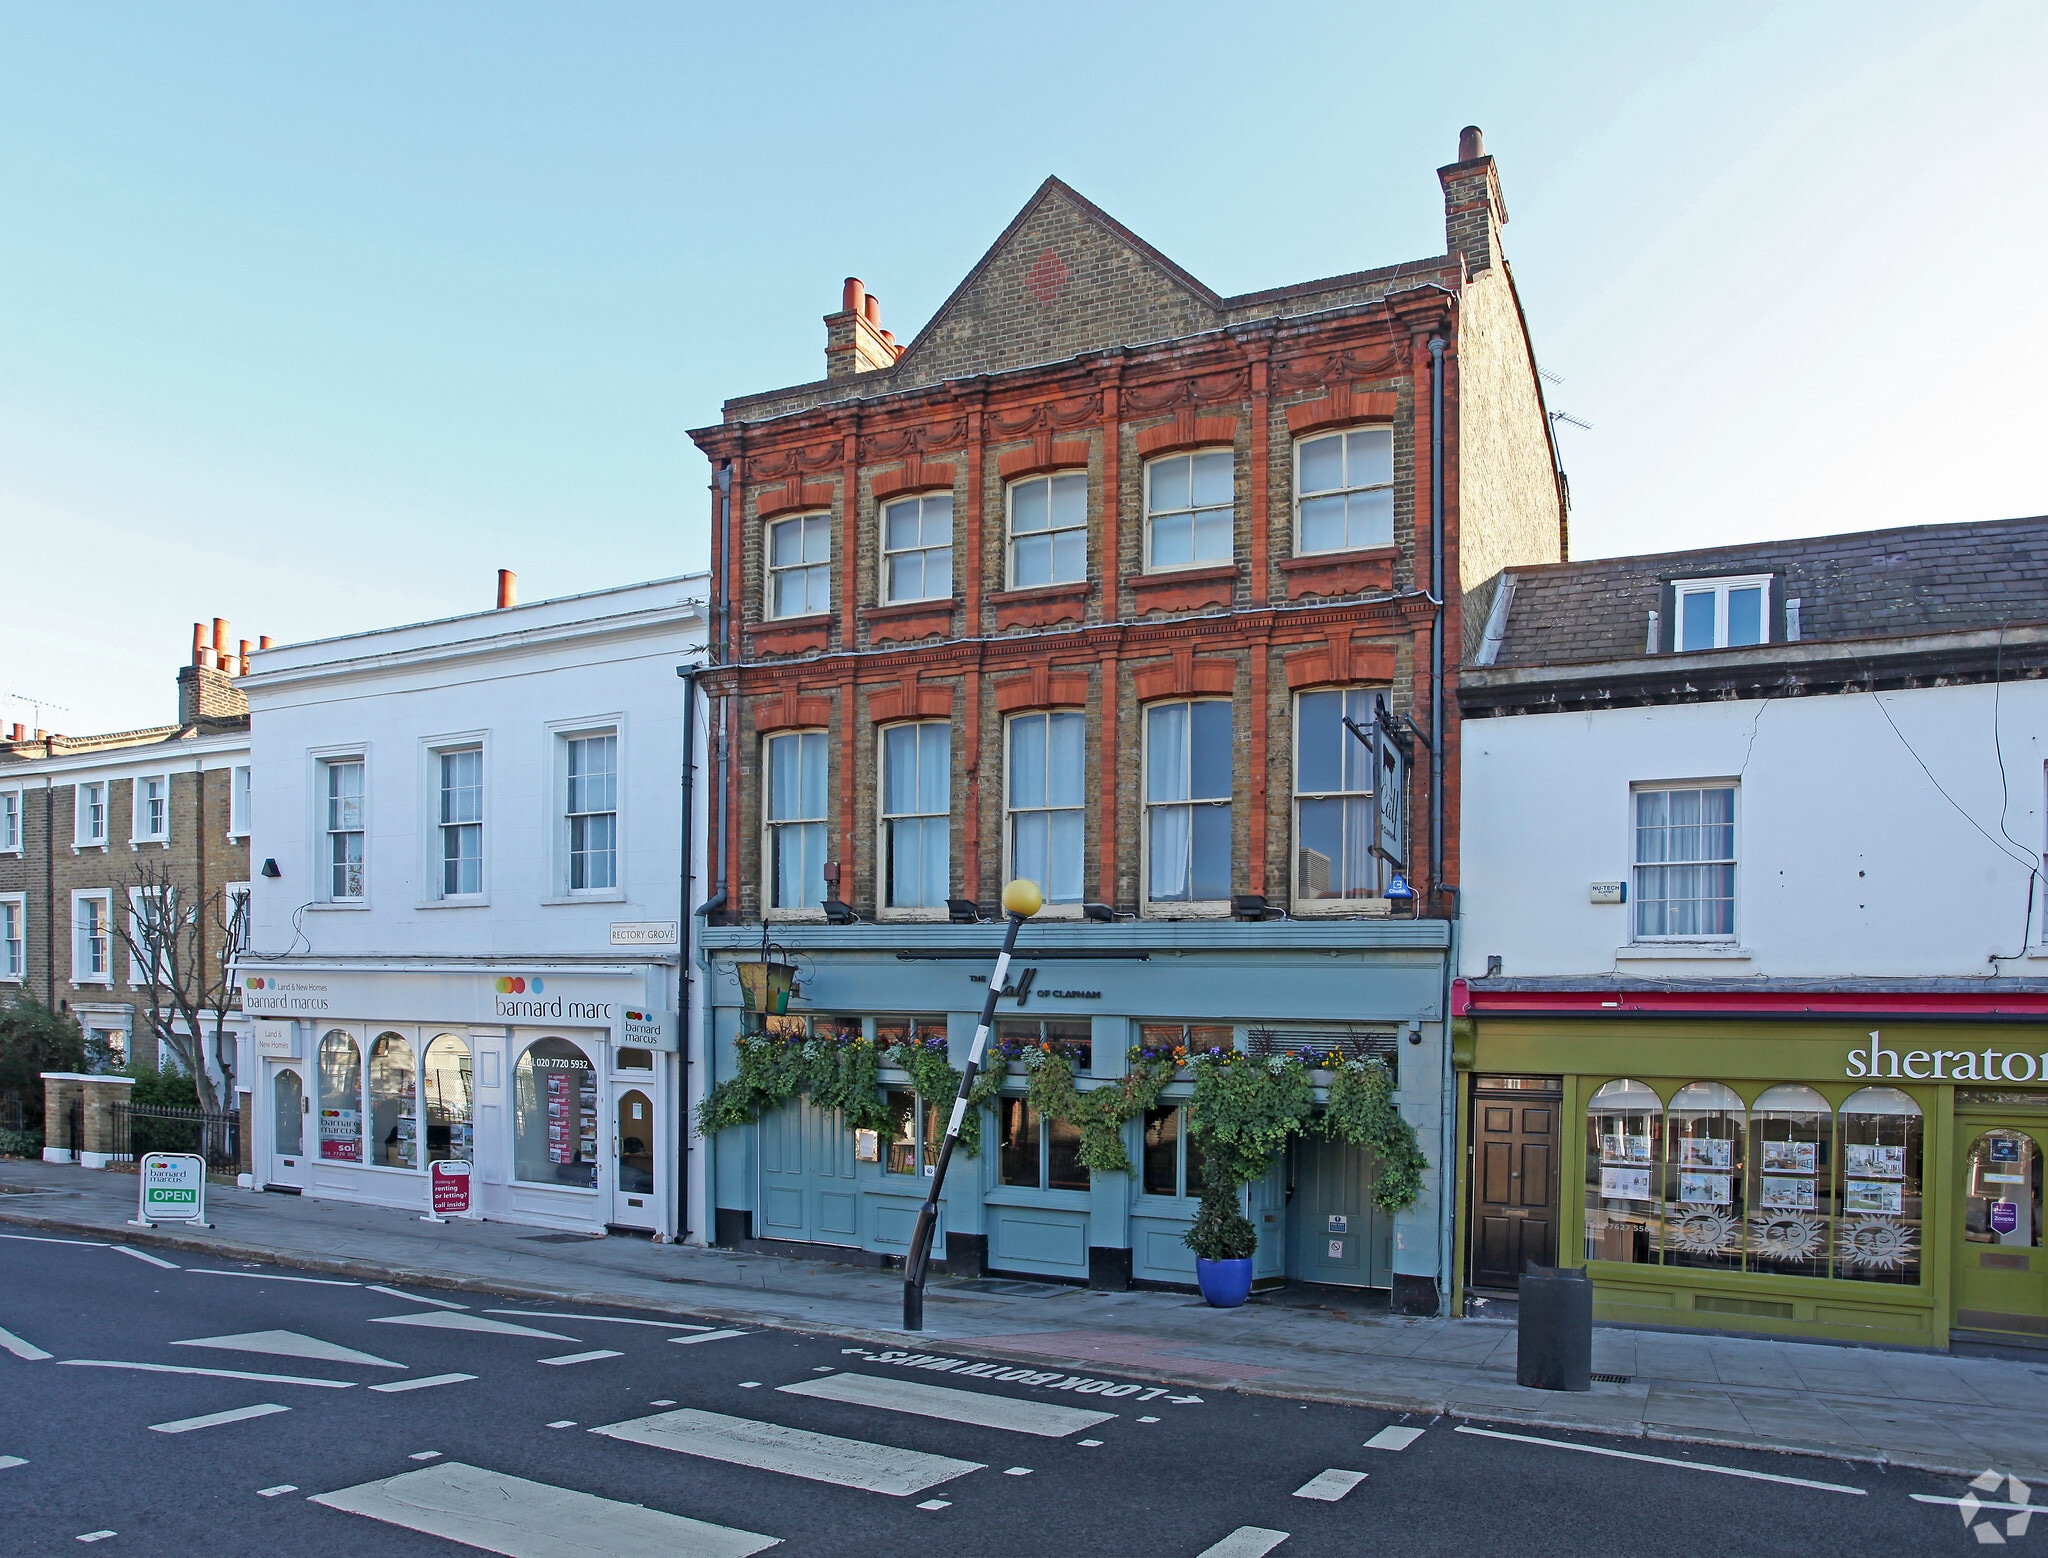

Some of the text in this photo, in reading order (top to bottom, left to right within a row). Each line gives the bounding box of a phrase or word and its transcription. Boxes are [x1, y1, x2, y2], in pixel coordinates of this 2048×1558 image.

[612, 930, 674, 939] RECTORY GROVE
[1037, 990, 1101, 998] OF CLAPHAM
[247, 994, 288, 1008] barnard
[290, 998, 328, 1010] marcus
[496, 996, 612, 1018] barnard marc
[626, 1022, 660, 1034] barnard
[626, 1034, 657, 1044] marcus
[536, 1058, 550, 1066] 020
[552, 1059, 568, 1068] 7720
[570, 1060, 588, 1068] 5932
[338, 1144, 355, 1152] sol
[154, 1190, 192, 1200] OPEN
[863, 1351, 1170, 1400] LOOK BOTH WAYS
